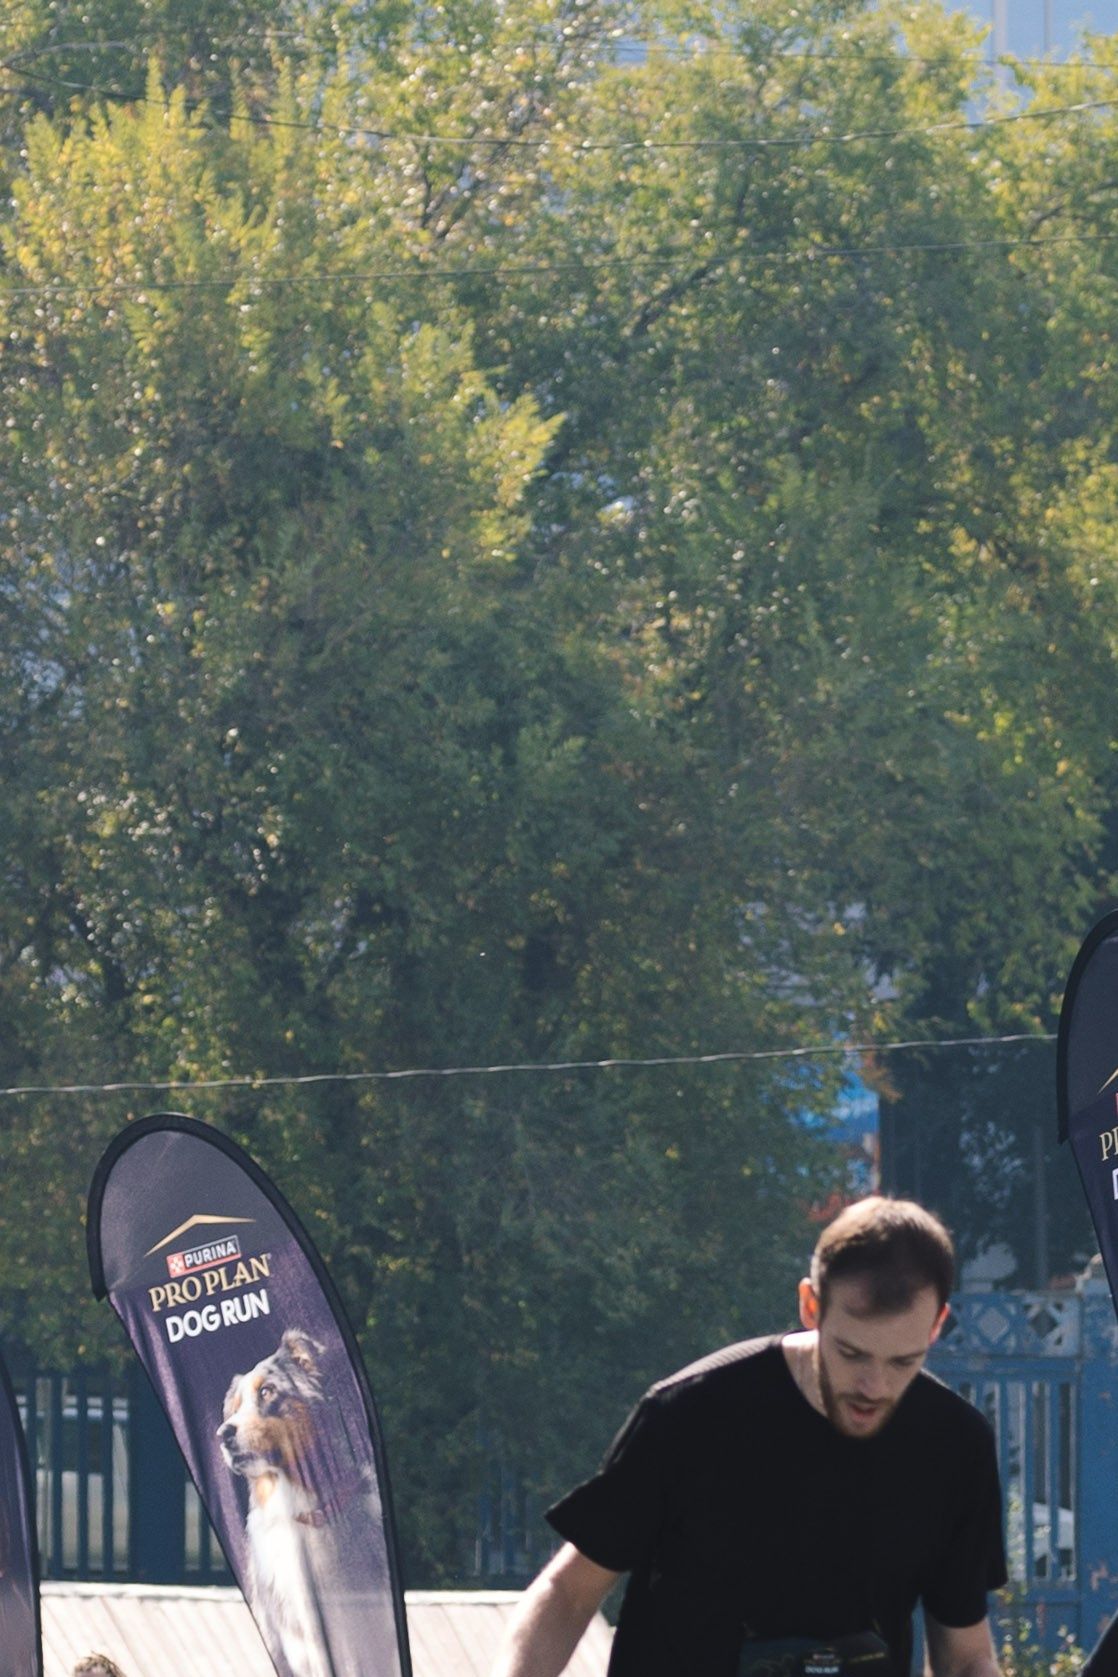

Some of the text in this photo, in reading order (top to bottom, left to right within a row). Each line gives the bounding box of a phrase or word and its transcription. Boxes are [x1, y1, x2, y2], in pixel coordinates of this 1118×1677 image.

[183, 1240, 237, 1268] PURINA
[148, 1252, 271, 1312] PRO PLAN
[165, 1288, 270, 1343] DOG RUN
